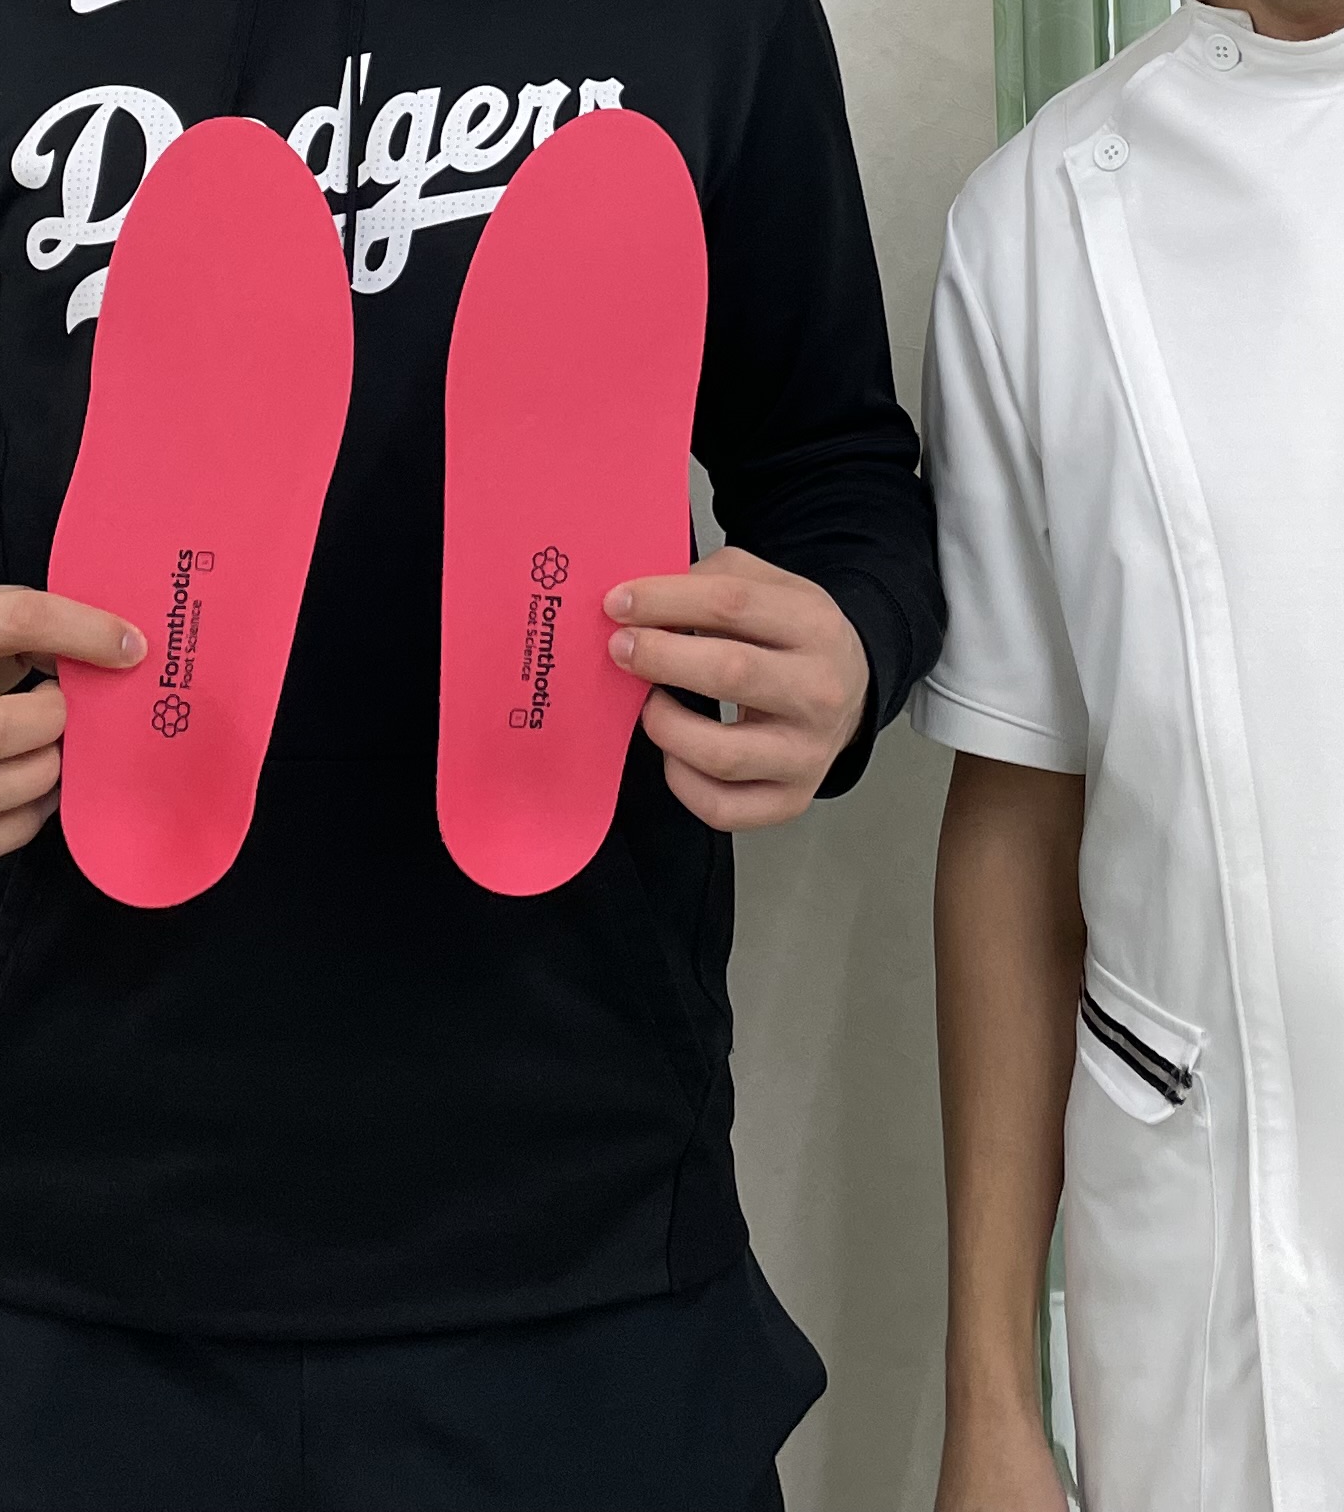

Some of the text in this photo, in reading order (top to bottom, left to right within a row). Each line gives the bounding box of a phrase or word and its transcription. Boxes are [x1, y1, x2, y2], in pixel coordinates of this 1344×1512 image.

[159, 549, 194, 689] Formthotics
[179, 599, 202, 690] Foot Science
[521, 594, 542, 682] Foot Science
[529, 595, 562, 729] Formthotics
